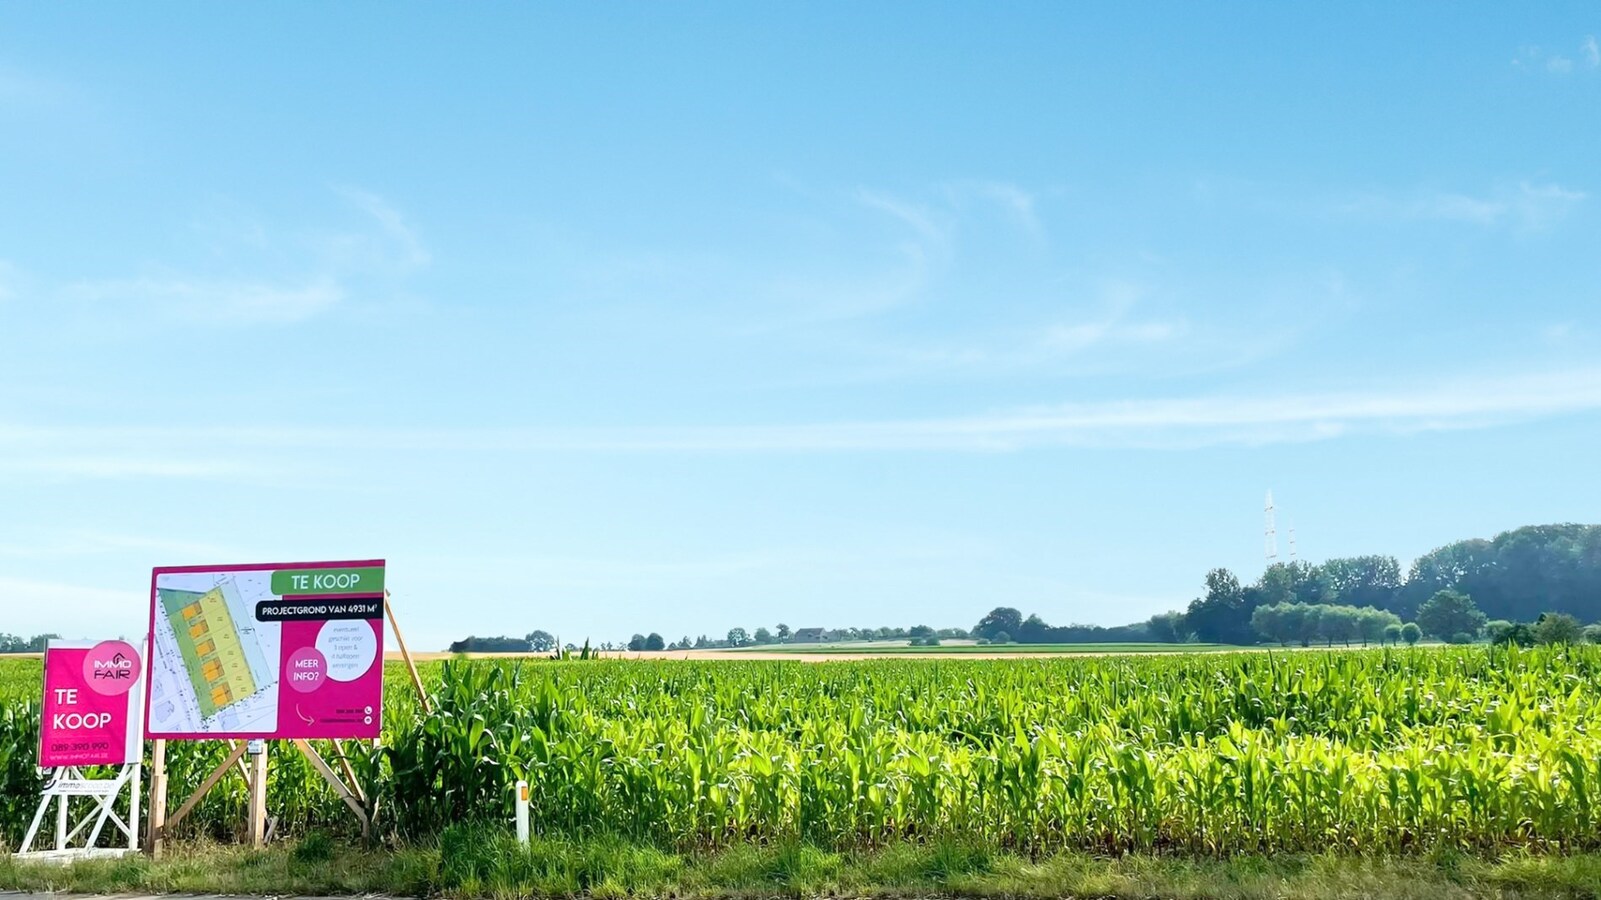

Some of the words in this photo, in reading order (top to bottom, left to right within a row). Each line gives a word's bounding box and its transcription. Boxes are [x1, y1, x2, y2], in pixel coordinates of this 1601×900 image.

[291, 575, 309, 589] TE
[313, 574, 360, 588] KOOP
[262, 606, 327, 616] PROJECTGROND
[328, 605, 346, 614] VAN
[347, 604, 366, 613] 4931
[94, 660, 132, 668] IMMO
[295, 659, 319, 668] MEER
[94, 670, 131, 679] FAIR
[293, 672, 320, 681] INFO?
[54, 689, 78, 705] TE
[53, 713, 112, 730] KOOP
[51, 743, 69, 752] 089
